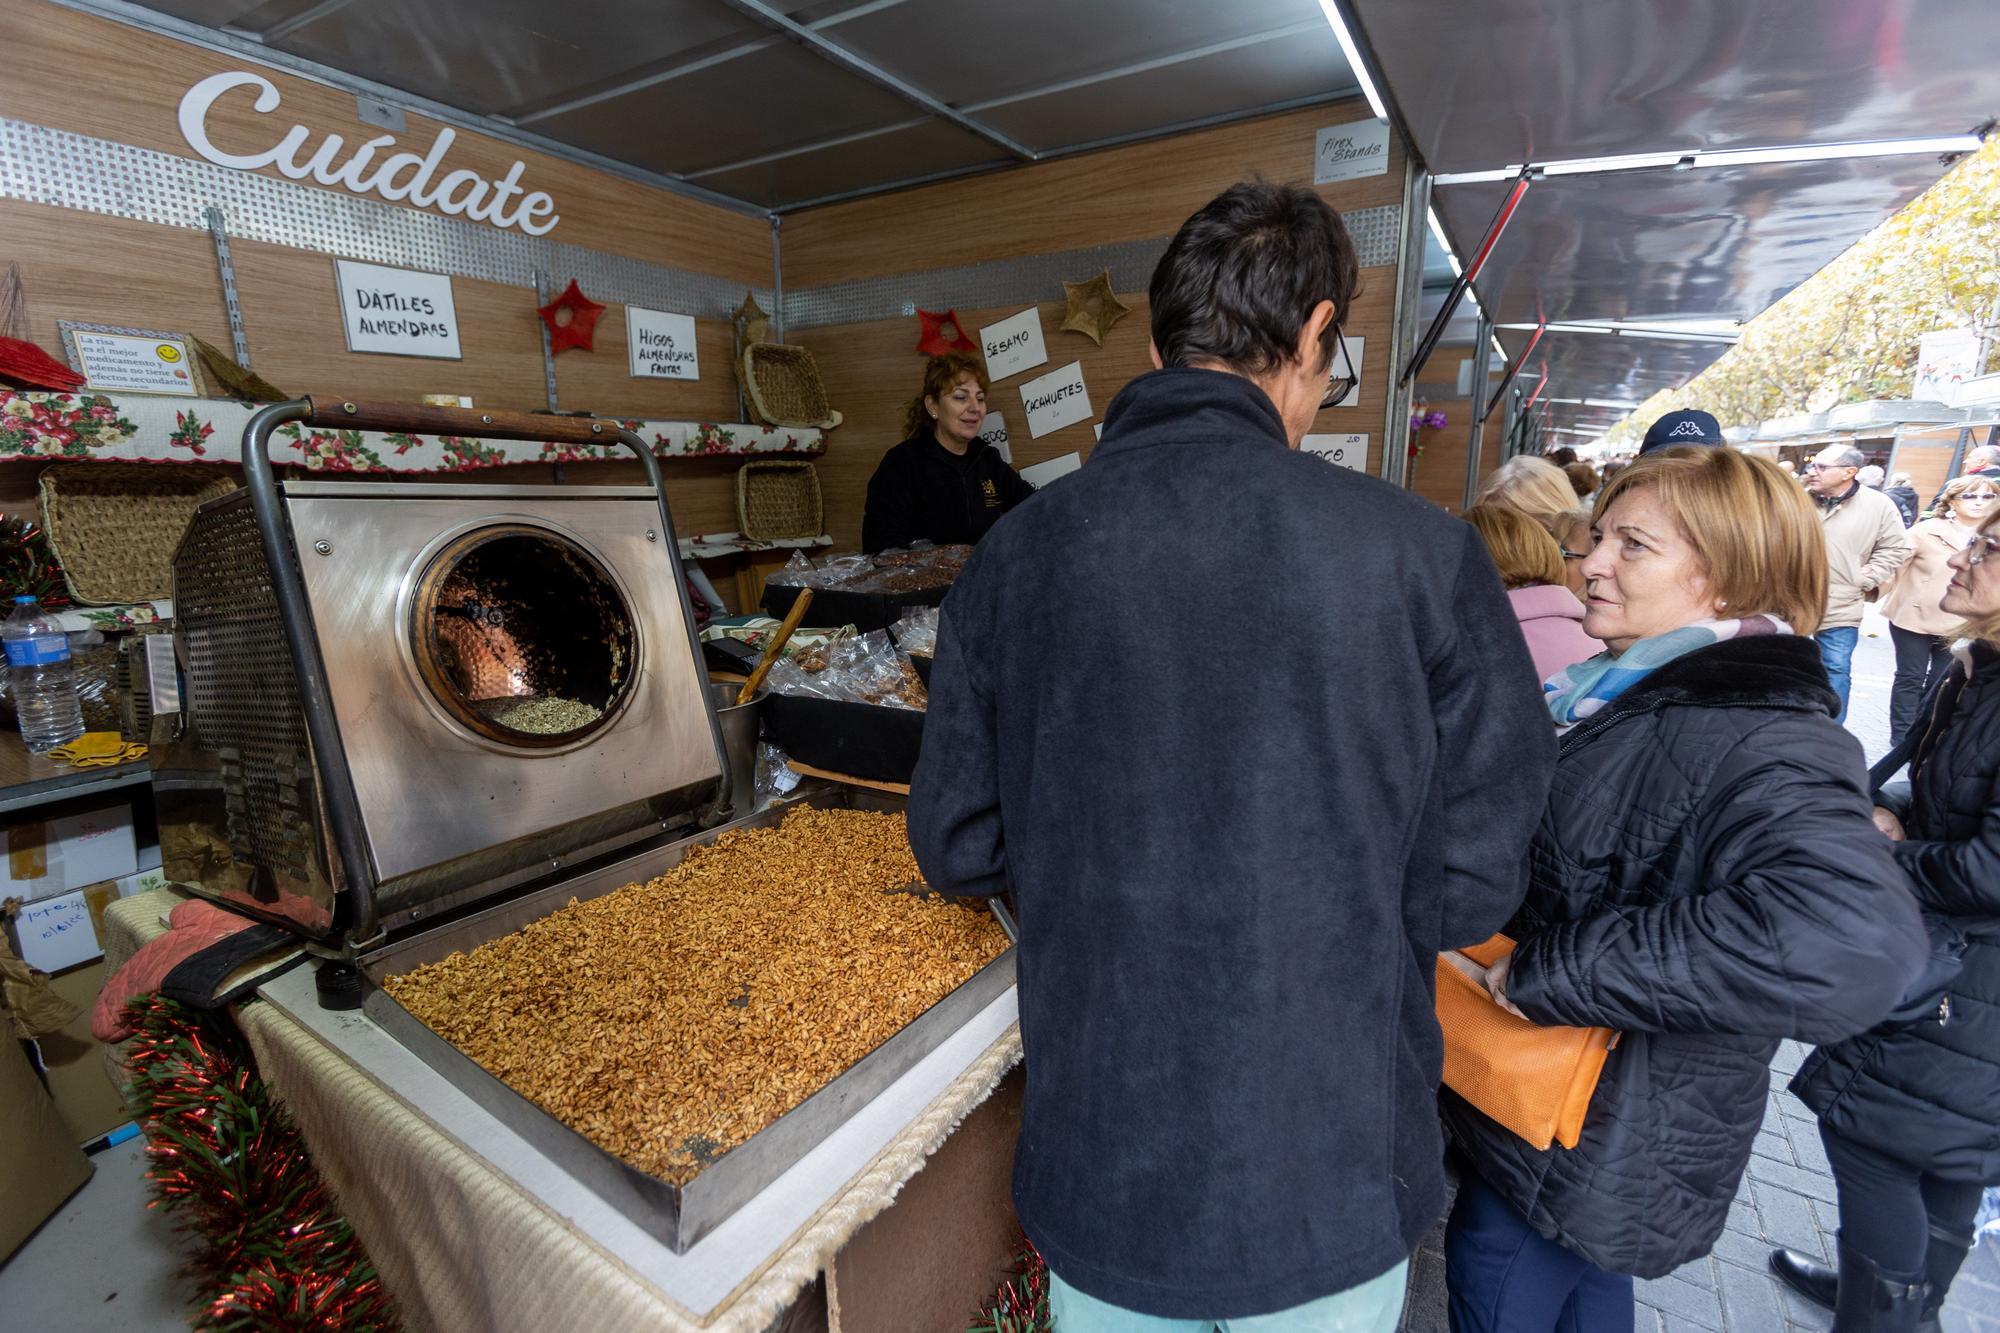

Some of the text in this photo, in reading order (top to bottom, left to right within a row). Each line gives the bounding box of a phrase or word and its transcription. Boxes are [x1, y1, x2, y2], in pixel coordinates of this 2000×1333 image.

[1322, 136, 1354, 155] firex
[178, 71, 560, 236] Cuídate
[360, 317, 448, 337] ALMENDRAS
[80, 335, 115, 346] La risa
[96, 346, 106, 354] el
[109, 348, 139, 357] mejor
[639, 348, 695, 363] ALMENDRAS
[86, 354, 155, 367] medicamento
[89, 364, 128, 373] además
[145, 368, 171, 377] tiene
[651, 363, 681, 375] FRUTAS
[91, 373, 128, 382] efectos
[1024, 381, 1083, 414] CACAHUETES
